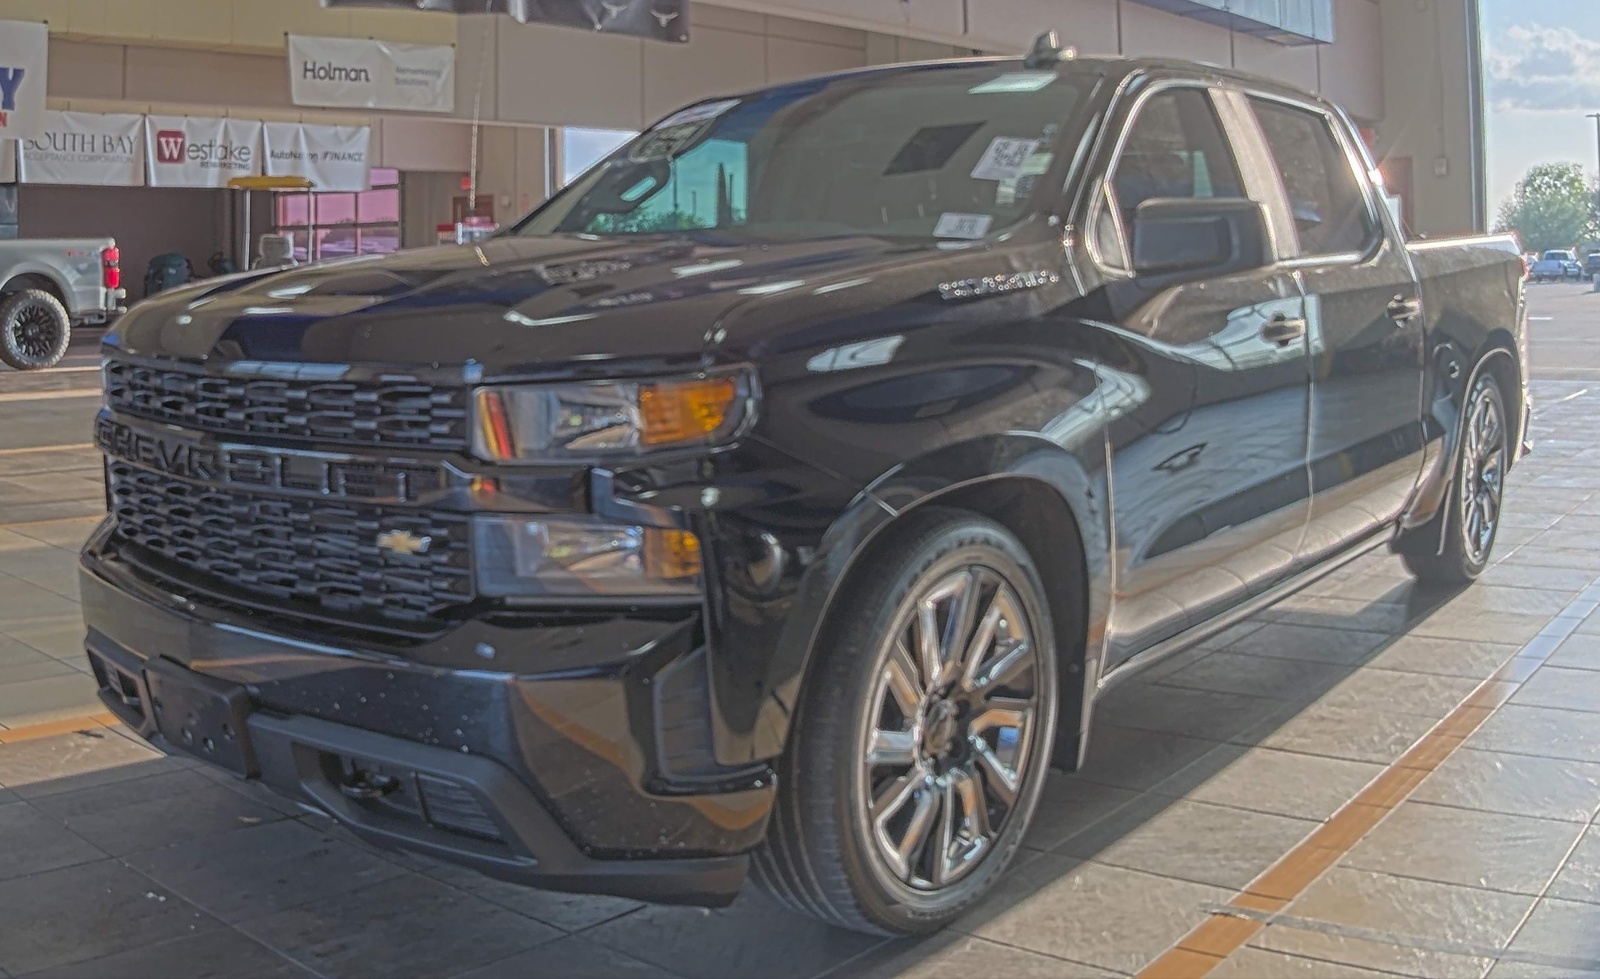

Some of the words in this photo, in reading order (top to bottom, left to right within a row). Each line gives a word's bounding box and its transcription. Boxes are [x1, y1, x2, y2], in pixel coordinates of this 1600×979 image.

[303, 61, 370, 82] Holman
[102, 134, 137, 155] BAY
[159, 137, 251, 162] Westlake
[97, 422, 438, 502] CHEVROLET
